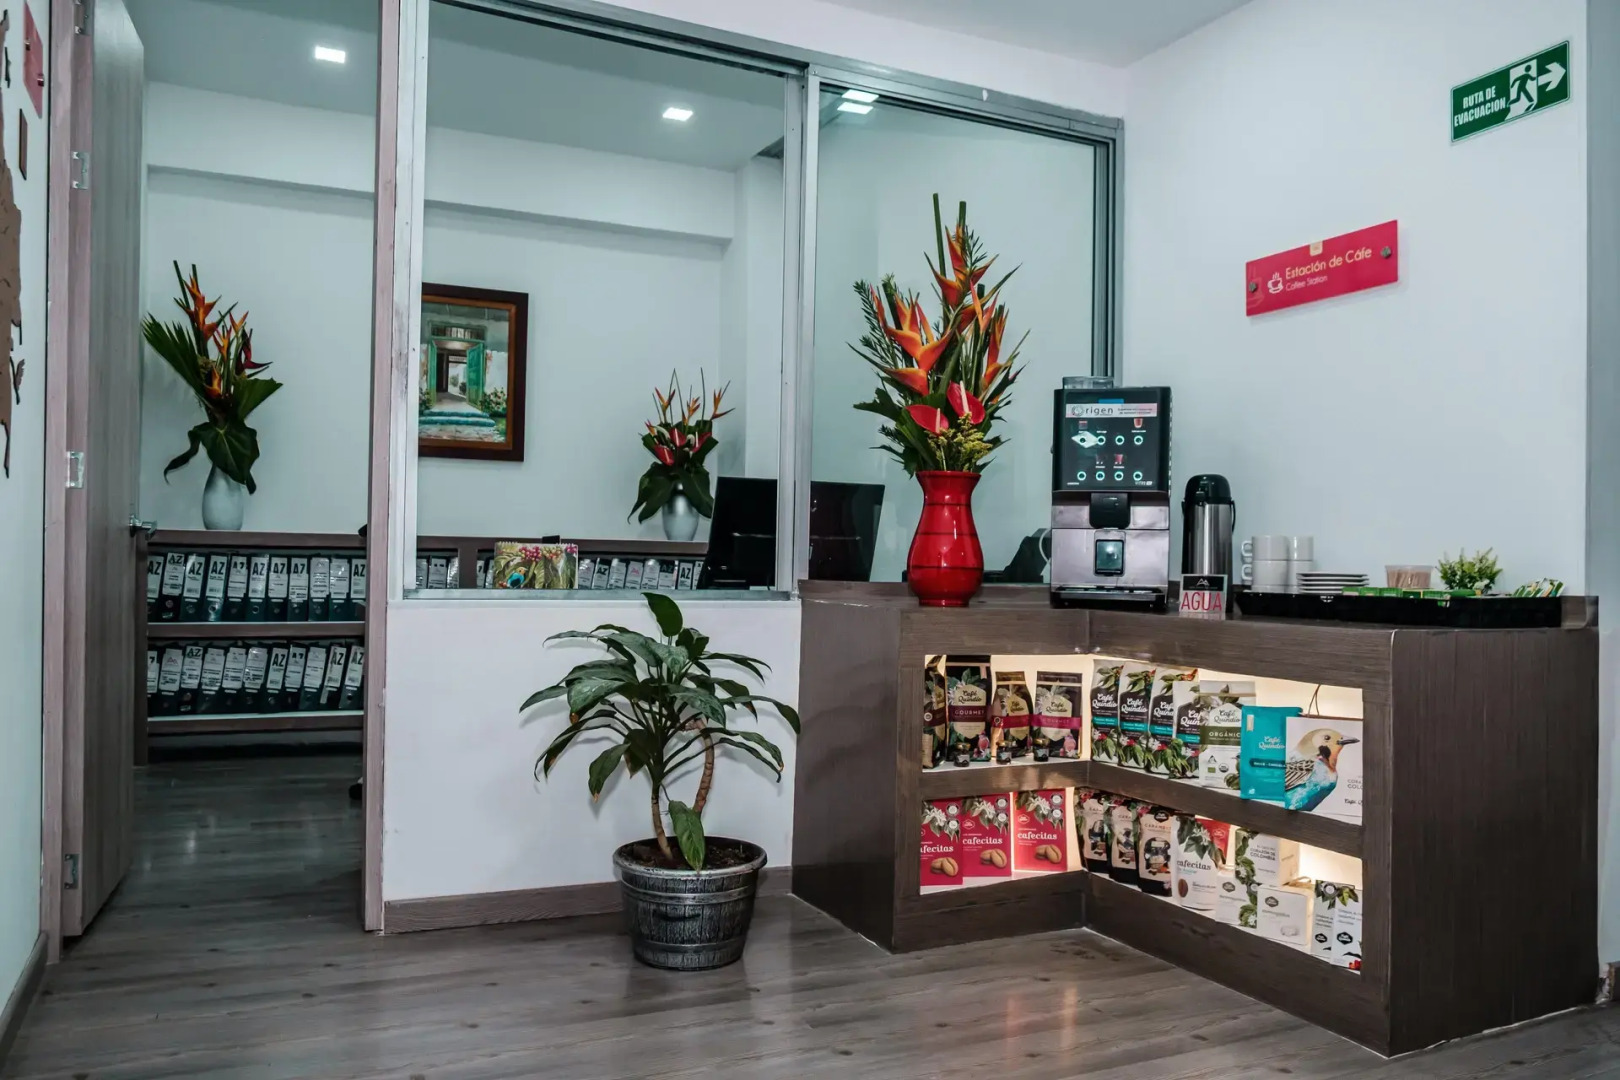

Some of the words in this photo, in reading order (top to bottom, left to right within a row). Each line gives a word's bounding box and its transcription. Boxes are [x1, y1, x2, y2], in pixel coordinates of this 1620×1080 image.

[1463, 91, 1484, 109] RUTA
[1486, 86, 1496, 100] DE
[1285, 260, 1326, 279] Estación
[1329, 255, 1343, 268] de
[1285, 280, 1306, 291] Coffee
[148, 561, 162, 576] AZ
[188, 562, 203, 576] AZ
[211, 561, 225, 575] AZ
[252, 562, 265, 576] AZ
[353, 564, 366, 577] AZ
[680, 567, 691, 579] AZ
[1181, 592, 1222, 610] AGUA
[272, 653, 286, 667] AZ
[330, 652, 344, 665] AZ
[350, 652, 364, 665] AZ
[1097, 693, 1113, 701] Café
[1127, 698, 1142, 706] Café
[1160, 701, 1173, 709] Caf
[962, 837, 1003, 845] cafecitas
[1017, 831, 1058, 840] cafecitas
